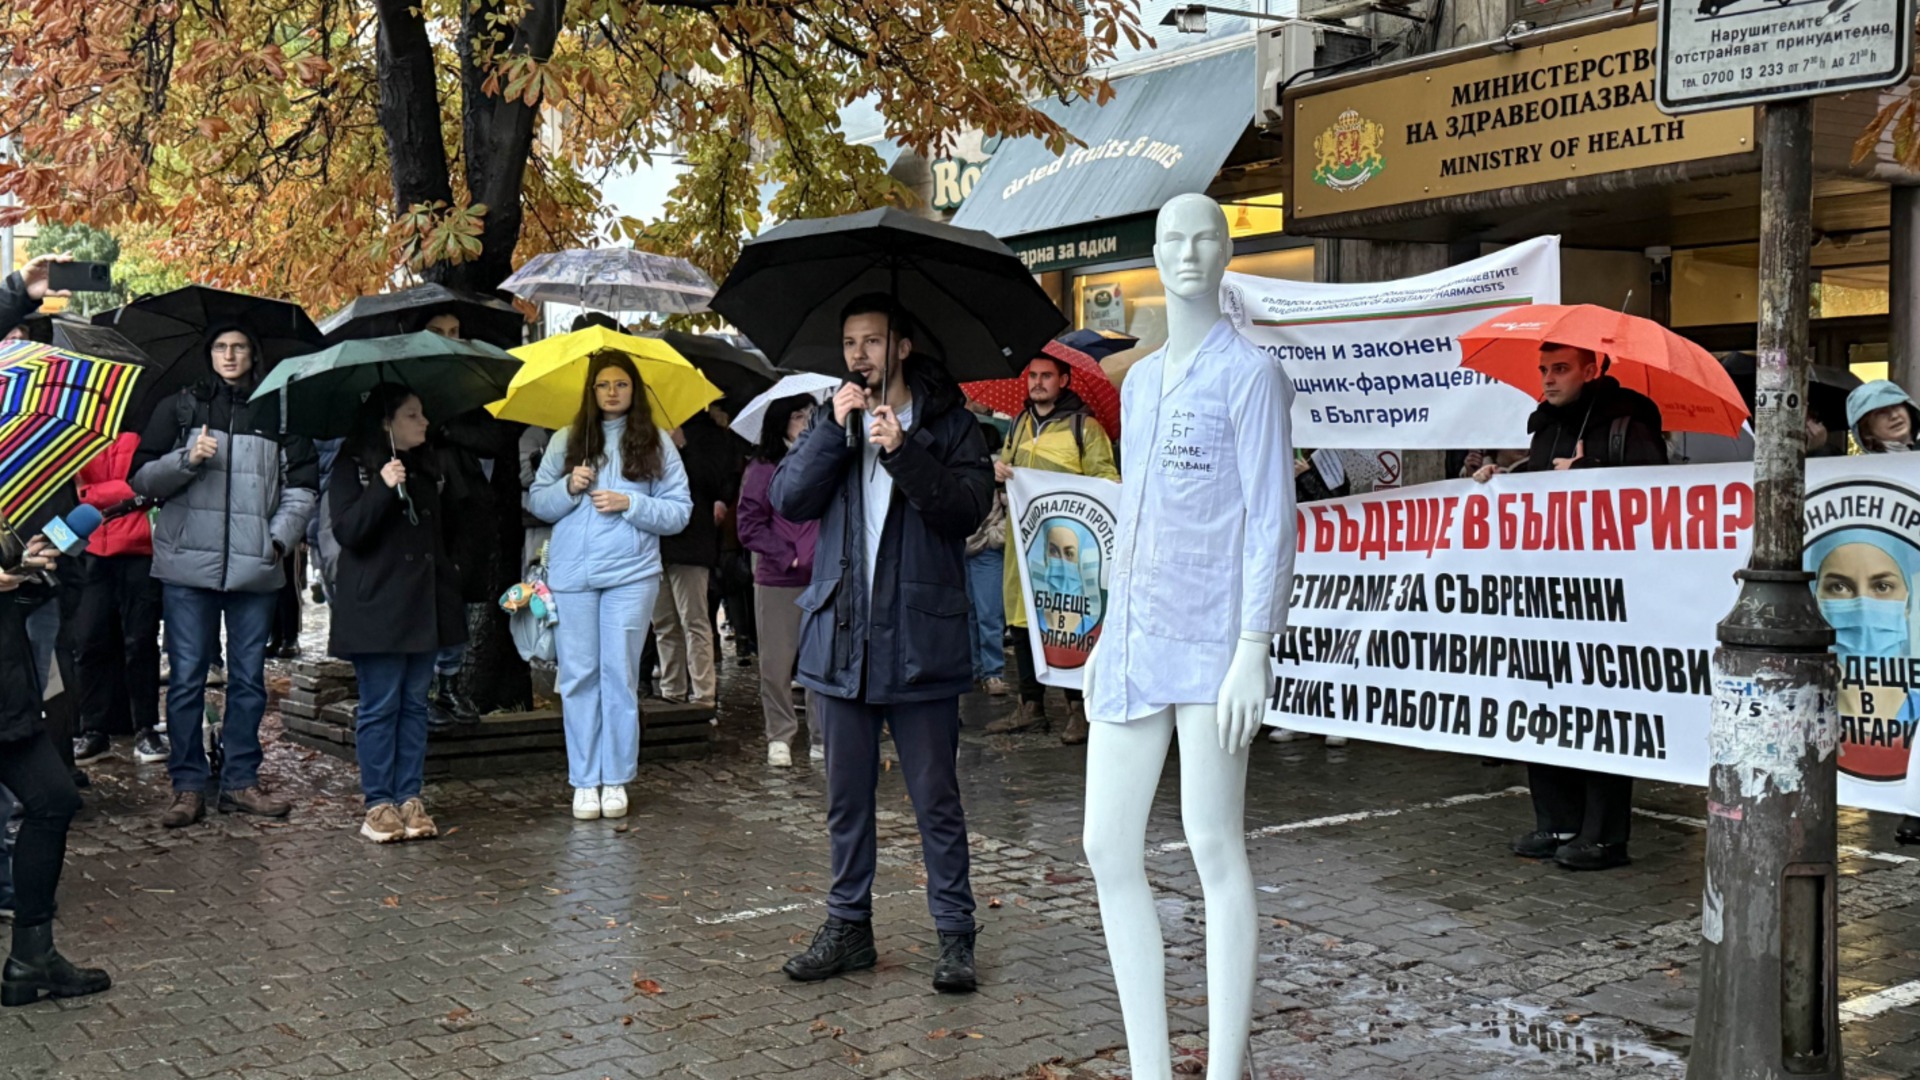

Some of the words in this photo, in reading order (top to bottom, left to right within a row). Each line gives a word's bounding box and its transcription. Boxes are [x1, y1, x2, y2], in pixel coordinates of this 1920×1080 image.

[1711, 16, 1823, 43] Нарушителите
[1675, 41, 1768, 65] отстраняват
[1682, 77, 1698, 89] тел.
[1702, 69, 1734, 86] 0700
[1741, 66, 1753, 79] 13
[1759, 63, 1784, 78] 233
[1788, 64, 1800, 74] от
[1831, 58, 1844, 69] до
[1406, 121, 1438, 145] НА
[1439, 144, 1543, 177] MINISTRY
[1550, 137, 1579, 159] OF
[1588, 120, 1685, 153] HEALTH
[932, 159, 988, 208] Ro
[1003, 154, 1066, 200] dried
[1066, 137, 1124, 169] fruits
[1126, 136, 1148, 157] &
[1142, 140, 1184, 170] nuts
[1016, 245, 1055, 270] арна
[1058, 244, 1075, 260] за
[1078, 236, 1117, 260] ядки
[1333, 342, 1346, 358] и
[1353, 334, 1452, 359] законен
[1312, 409, 1322, 423] в
[1326, 405, 1429, 428] България
[1022, 499, 1087, 544] АЦИОНАЛЕН
[1314, 493, 1459, 560] БЪДЕЩЕ
[1462, 494, 1490, 550] В
[1499, 482, 1754, 551] БЪЛГАРИЯ?
[1034, 590, 1091, 616] БЪДЕЩЕ
[1434, 572, 1627, 622] СЪВРЕМЕННИ
[1058, 615, 1066, 629] В
[1366, 629, 1572, 689] МОТИВИРАЩИ
[1576, 642, 1712, 696] УСЛОВИ
[1842, 655, 1920, 694] ДЕЩЕ
[1861, 691, 1875, 714] В
[1341, 684, 1358, 722] И
[1365, 686, 1471, 736] РАБОТА
[1478, 697, 1498, 738] В
[1506, 700, 1667, 760] СФЕРАТА!
